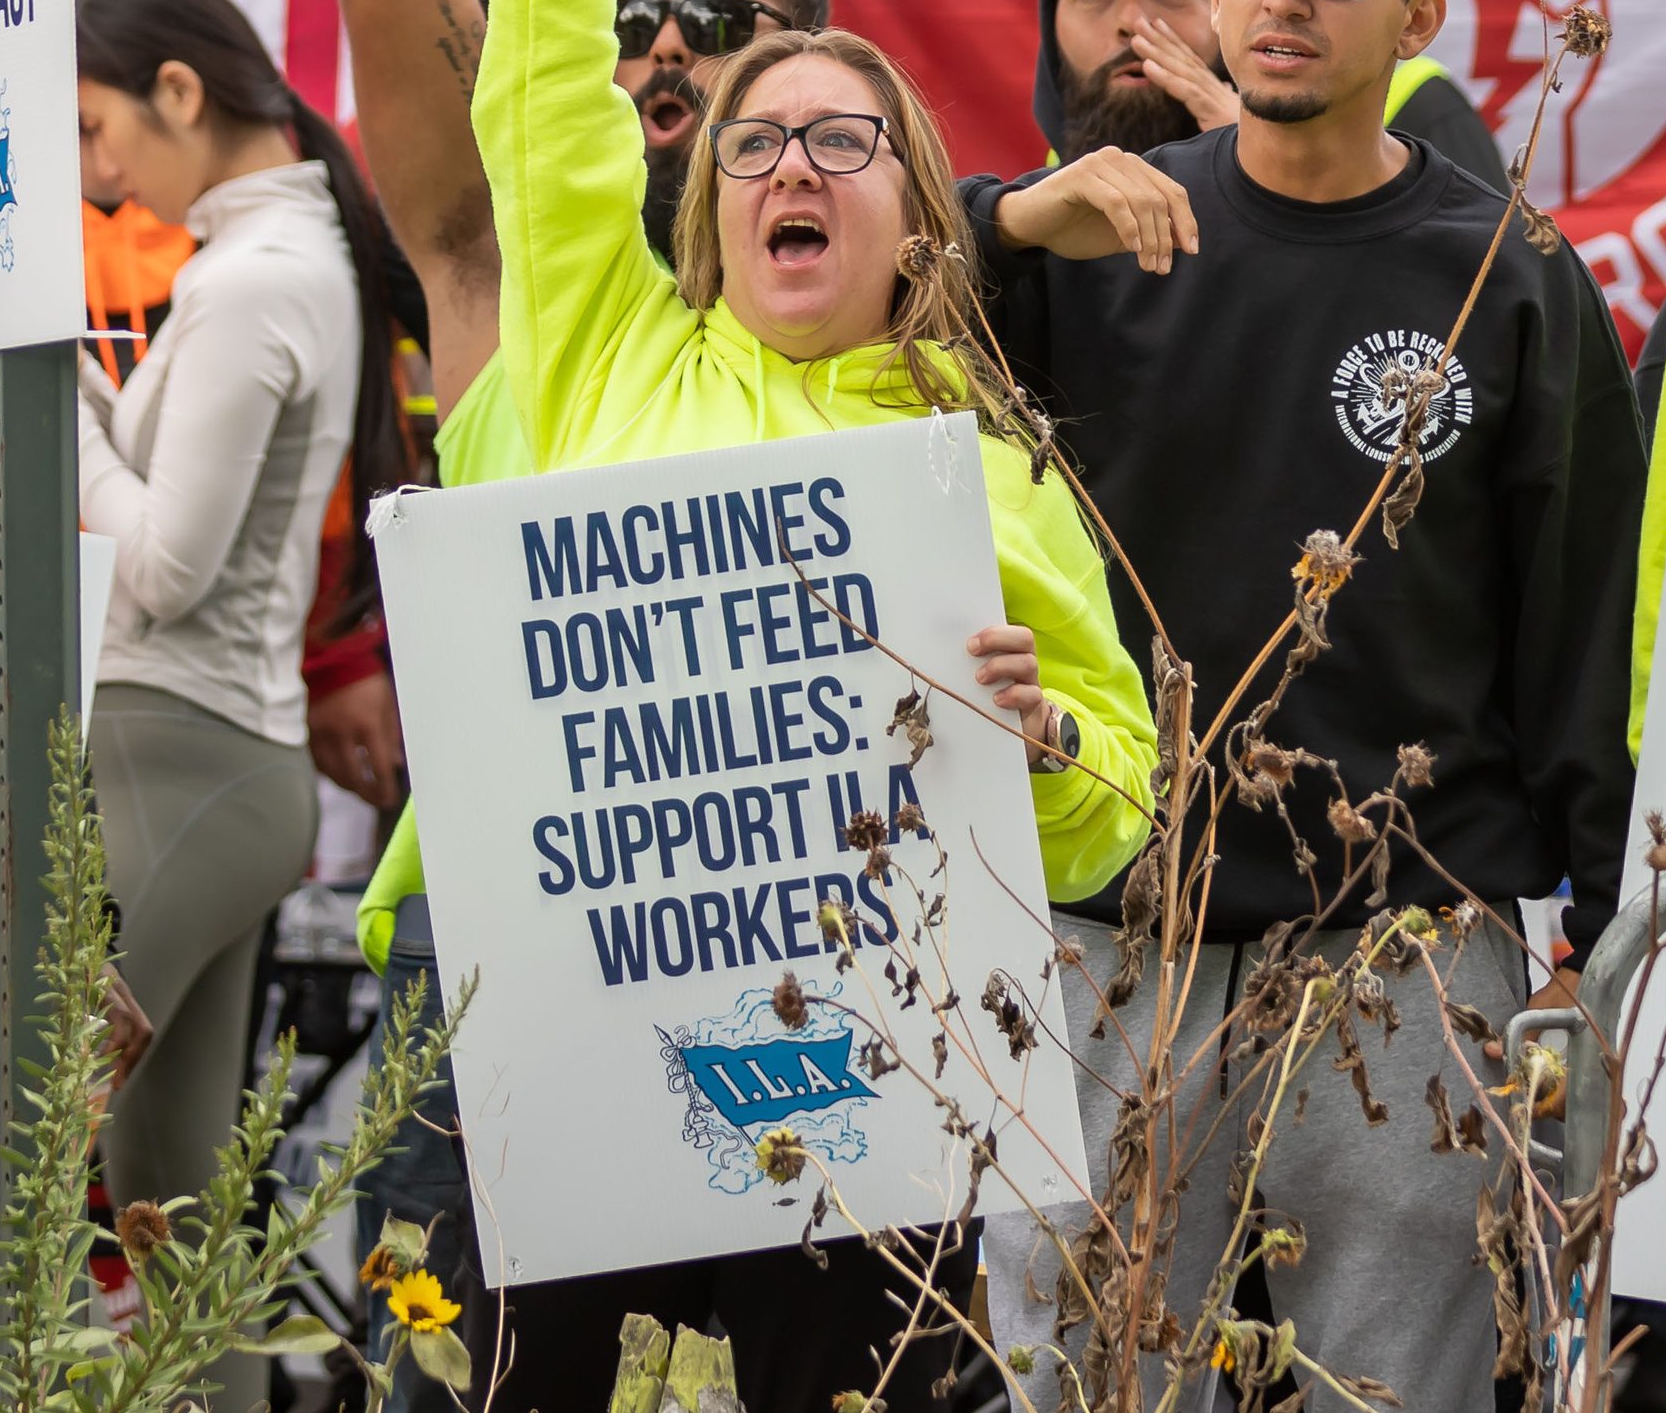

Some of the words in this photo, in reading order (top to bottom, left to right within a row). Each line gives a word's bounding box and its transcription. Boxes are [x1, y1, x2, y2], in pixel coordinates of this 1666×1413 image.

[1333, 344, 1368, 386] FORCE
[1364, 333, 1385, 354] TO
[1387, 329, 1405, 348] BE
[1409, 330, 1467, 384] RECKNED
[1331, 390, 1349, 399] A
[1454, 387, 1473, 425] WITH
[1335, 404, 1367, 452] INTERNATIONAL
[1425, 428, 1461, 462] ASSOCIATION
[520, 476, 851, 601] MACHINES
[522, 596, 704, 700] DON'T
[723, 572, 880, 670] FEED
[561, 674, 869, 793] FAMILIES:
[533, 777, 810, 896] SUPPORT
[586, 866, 899, 986] WORKERS
[709, 1051, 852, 1107] I.L.A.
